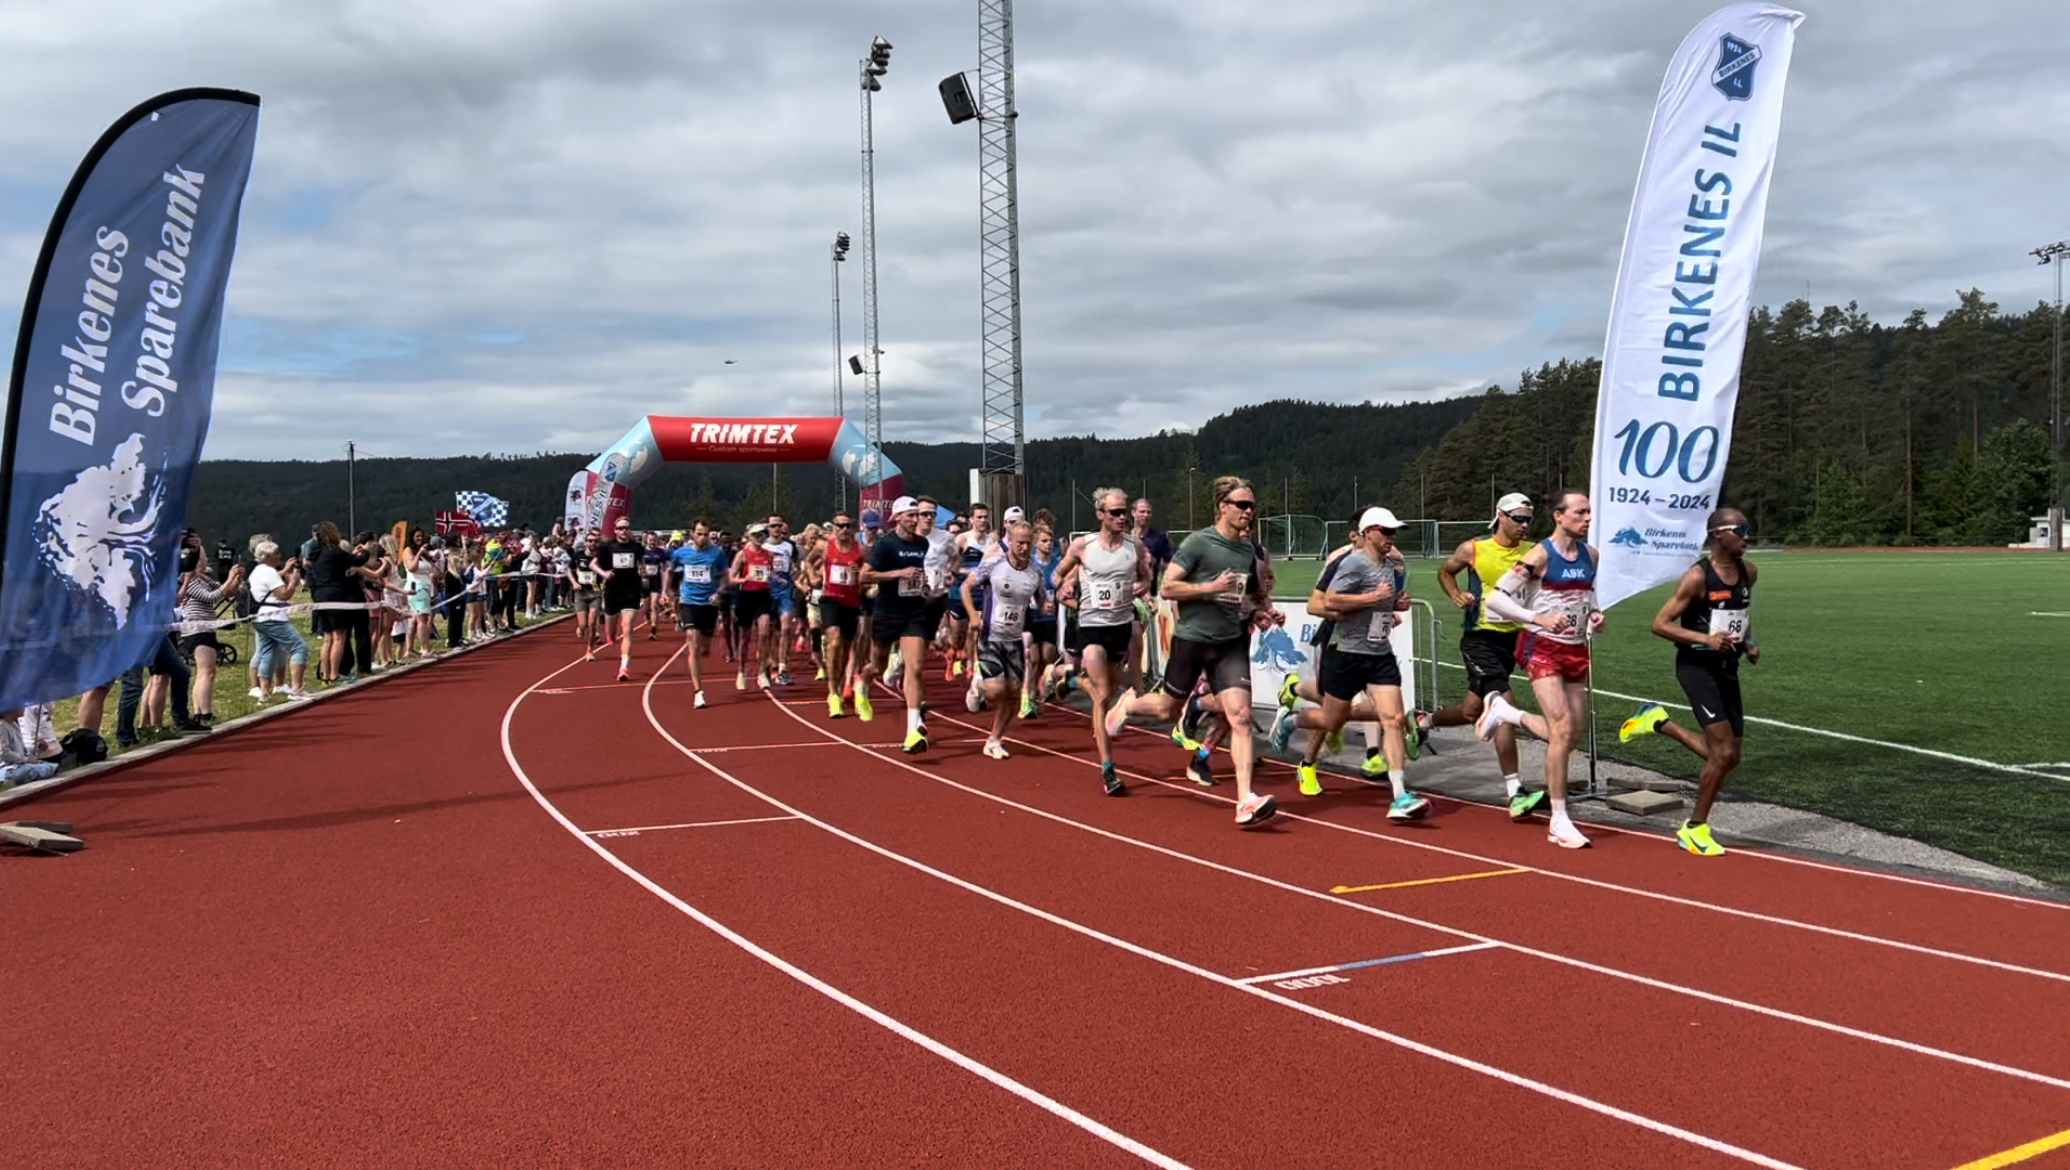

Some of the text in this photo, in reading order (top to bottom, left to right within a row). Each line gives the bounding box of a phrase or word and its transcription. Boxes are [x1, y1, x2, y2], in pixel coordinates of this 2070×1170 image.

[1658, 122, 1741, 401] BIRKENES IL
[121, 163, 205, 418] Sparebank
[50, 225, 129, 446] Birkenes
[690, 423, 799, 444] TRIMTEX
[1614, 418, 1719, 483] 100
[1608, 486, 1650, 505] 1924
[1668, 493, 1711, 510] 2024
[1099, 589, 1111, 600] 20
[1562, 568, 1586, 579] ASK
